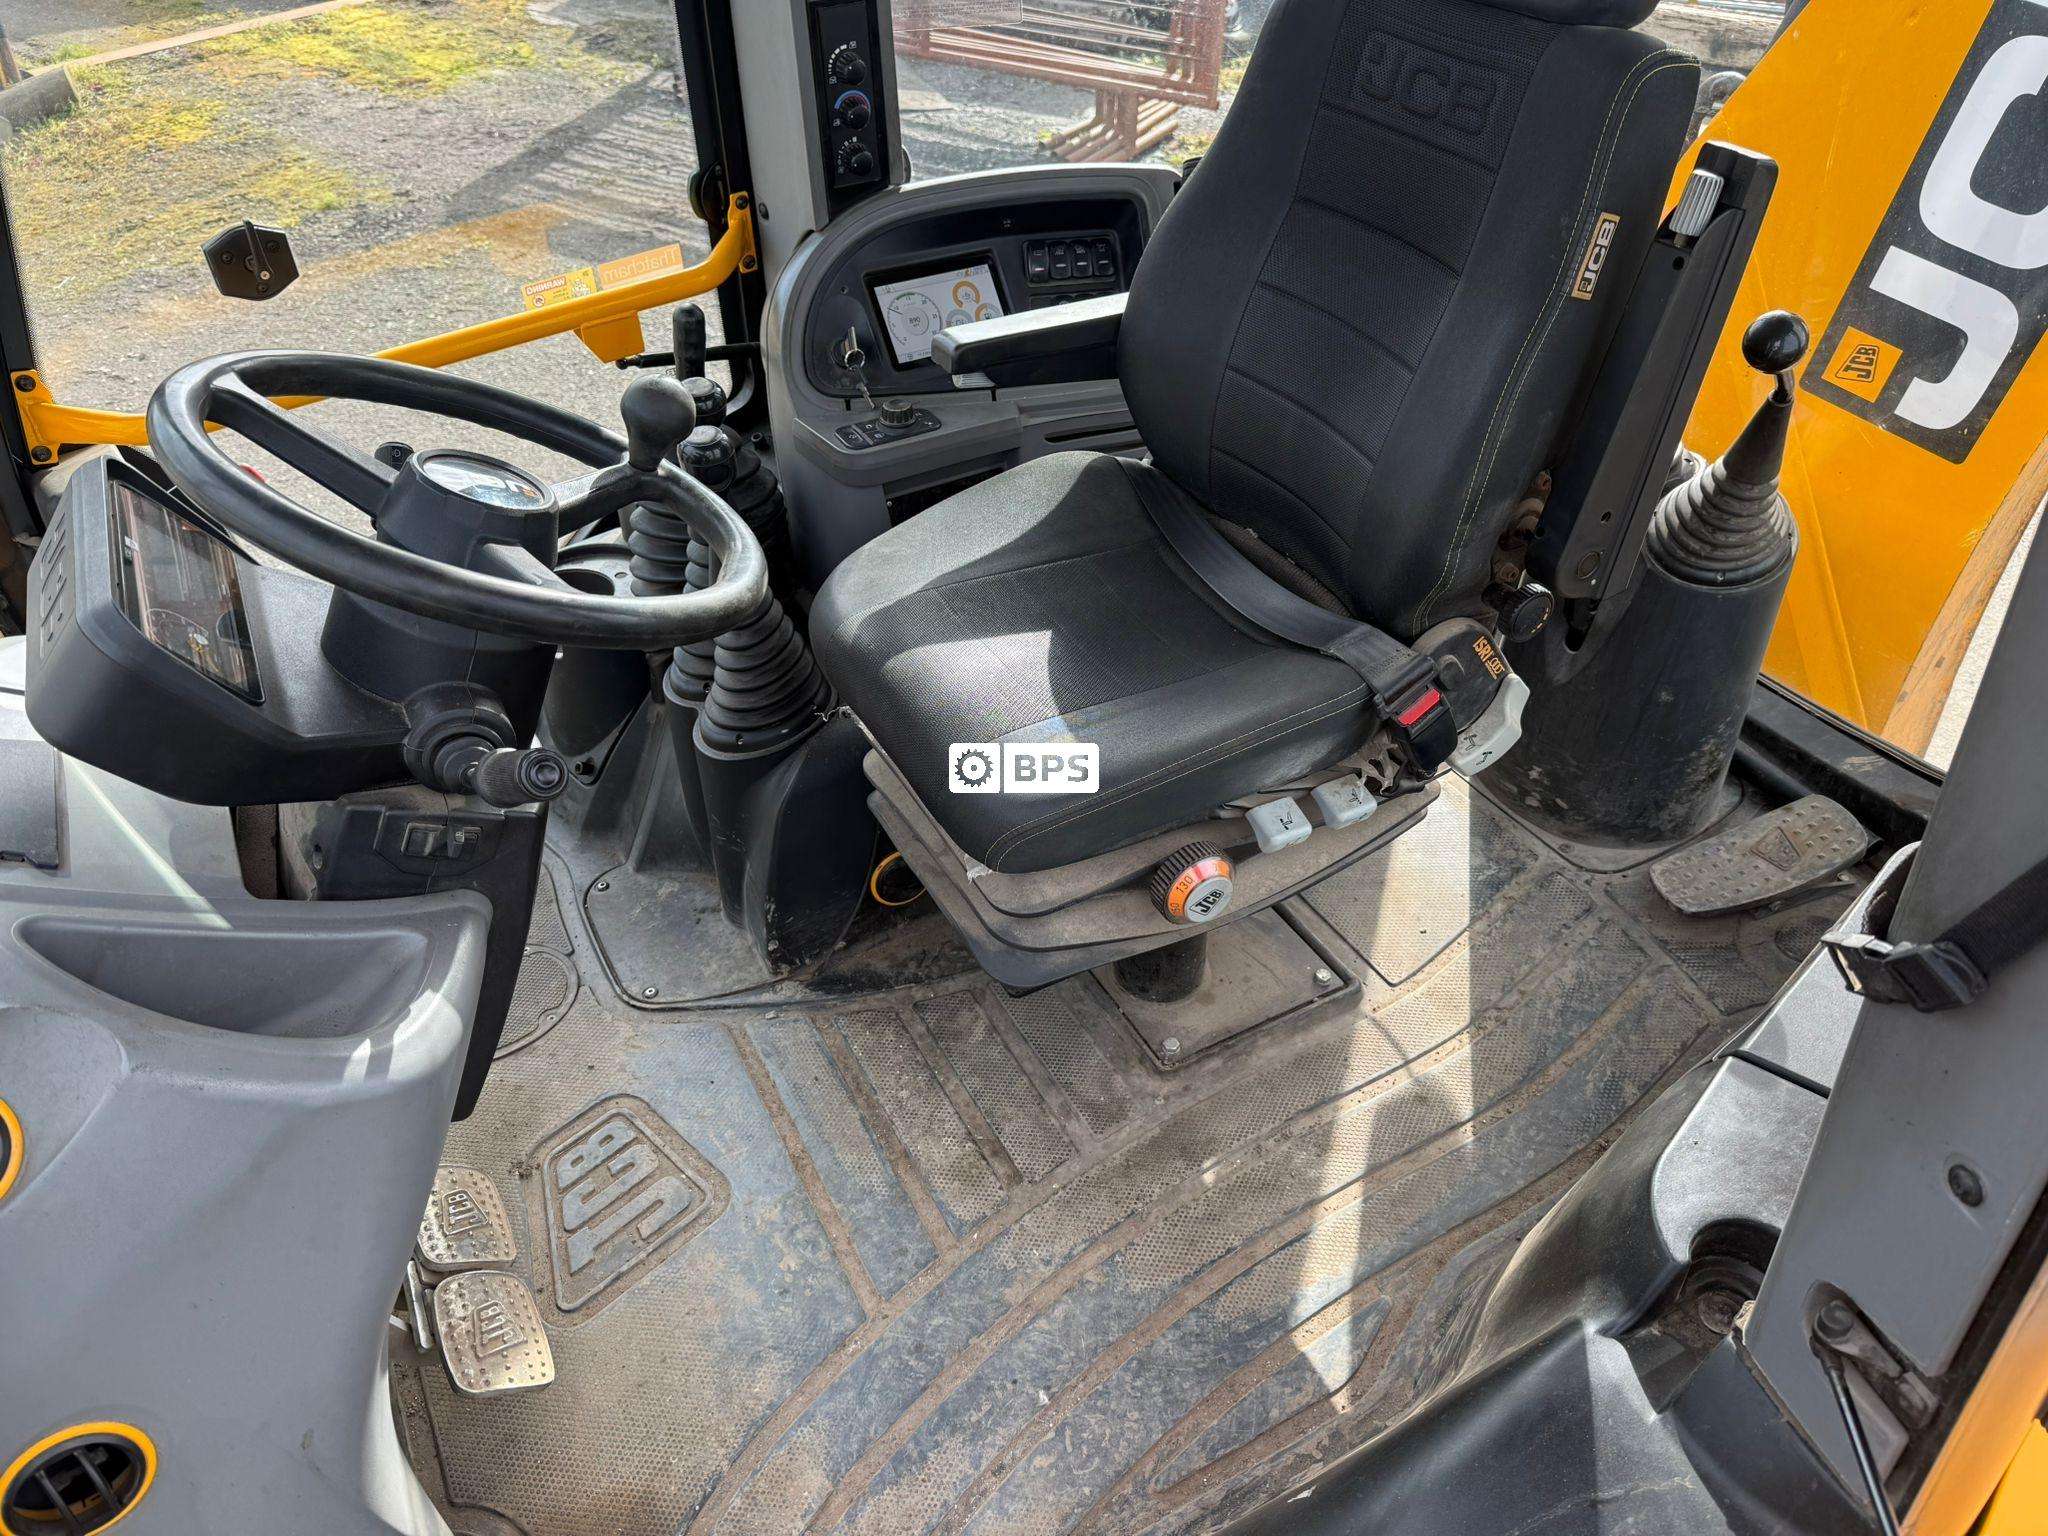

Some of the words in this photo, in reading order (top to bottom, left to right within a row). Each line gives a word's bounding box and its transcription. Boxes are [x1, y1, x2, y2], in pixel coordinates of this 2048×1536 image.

[1358, 42, 1499, 137] JCB
[1869, 0, 2048, 430] JC
[1583, 220, 1616, 292] JCB
[1842, 346, 1877, 380] JCB
[1472, 635, 1495, 663] ISRI
[1176, 875, 1194, 893] 130
[1195, 889, 1223, 914] JCB
[448, 1192, 485, 1227] JCB
[555, 1120, 692, 1277] JCB
[480, 1306, 515, 1346] JCB
